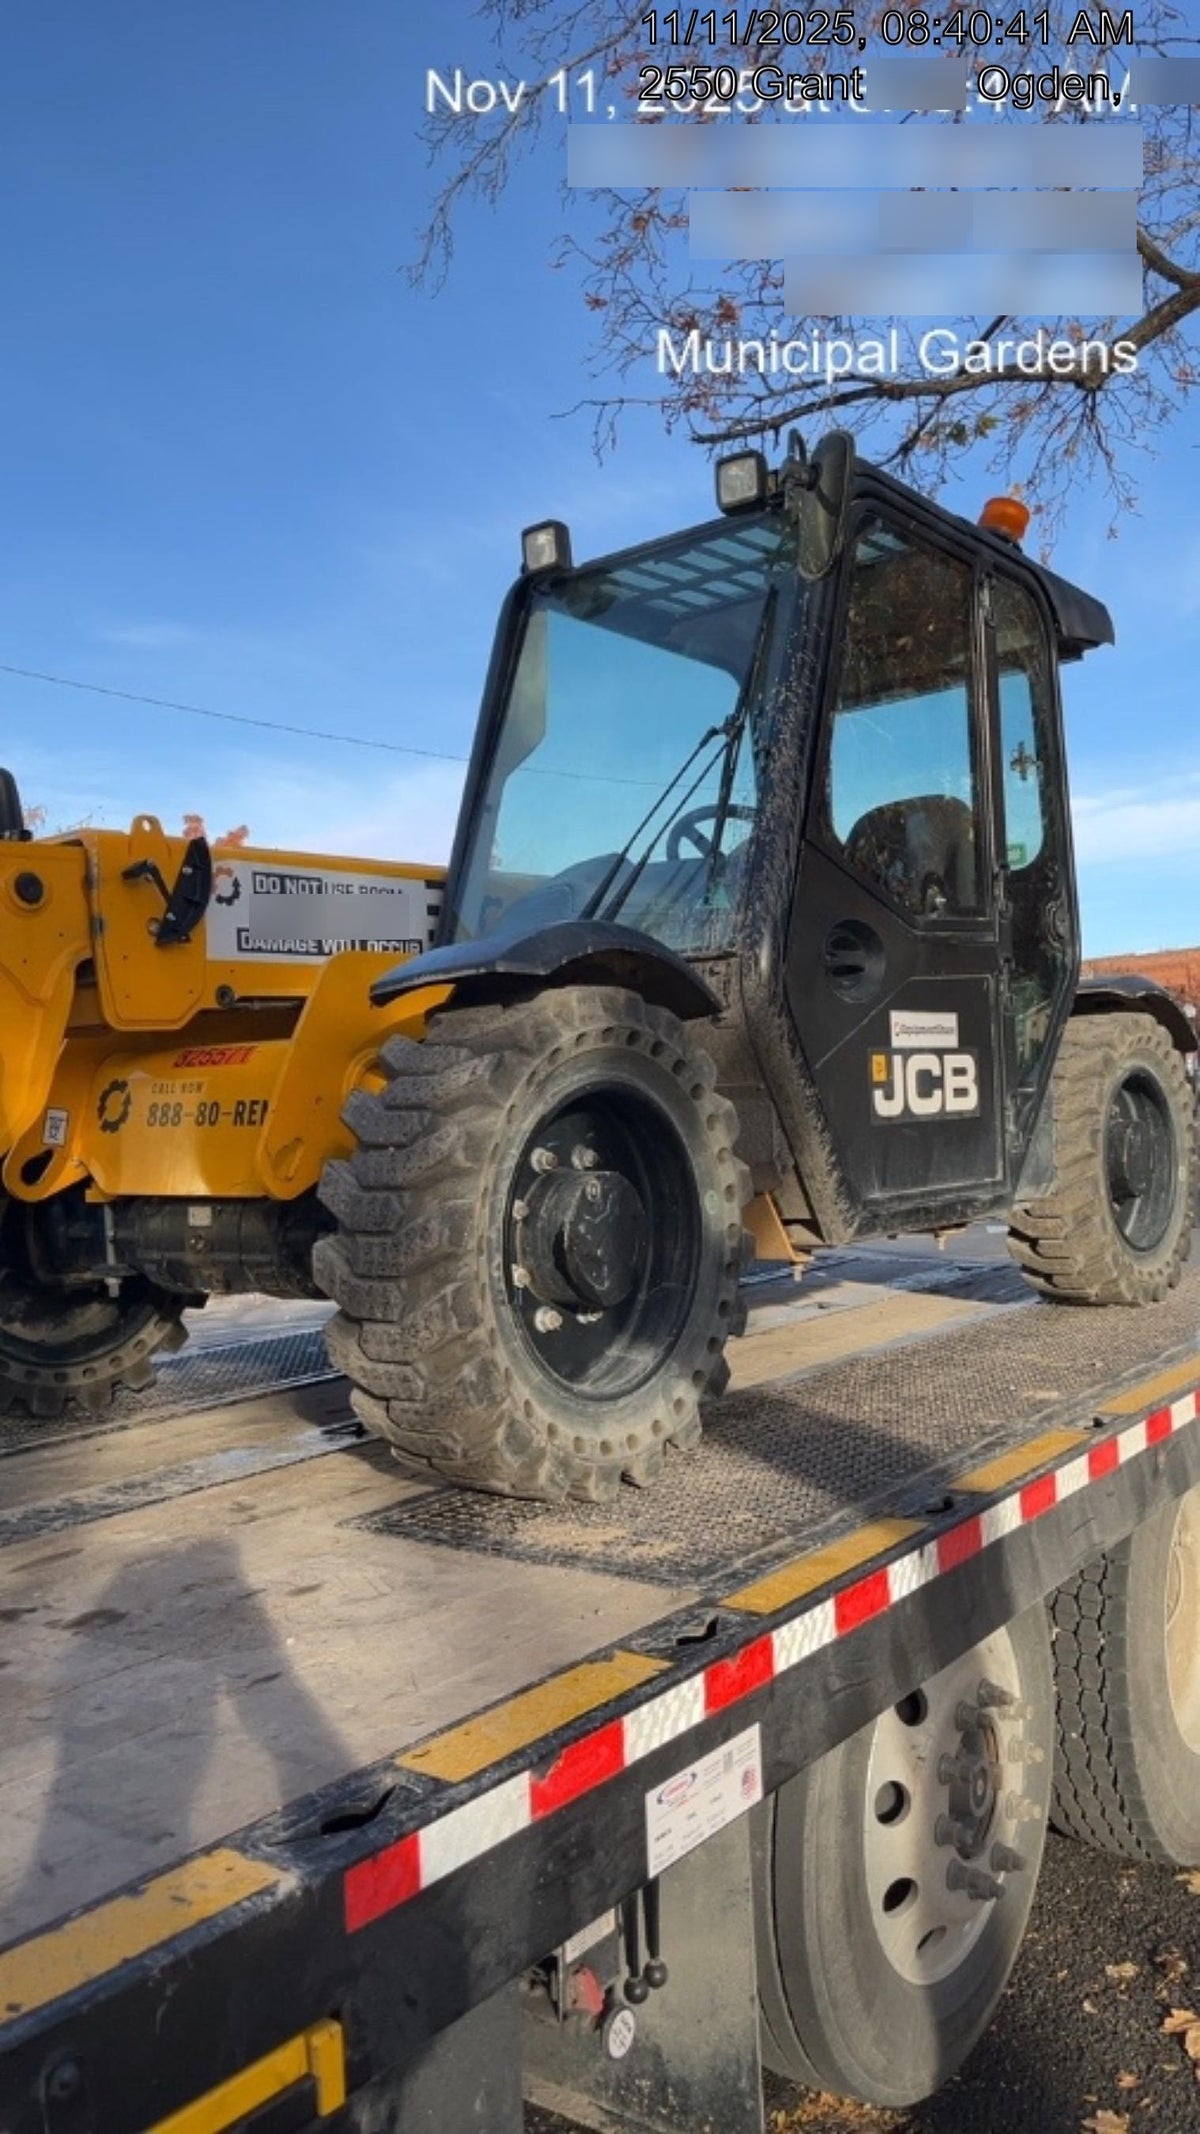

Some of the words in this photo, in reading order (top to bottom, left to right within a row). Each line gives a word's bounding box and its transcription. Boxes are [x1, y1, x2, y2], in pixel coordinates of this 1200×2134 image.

[255, 874, 281, 894] DO
[285, 878, 321, 894] NOT
[872, 1053, 978, 1118] JCB
